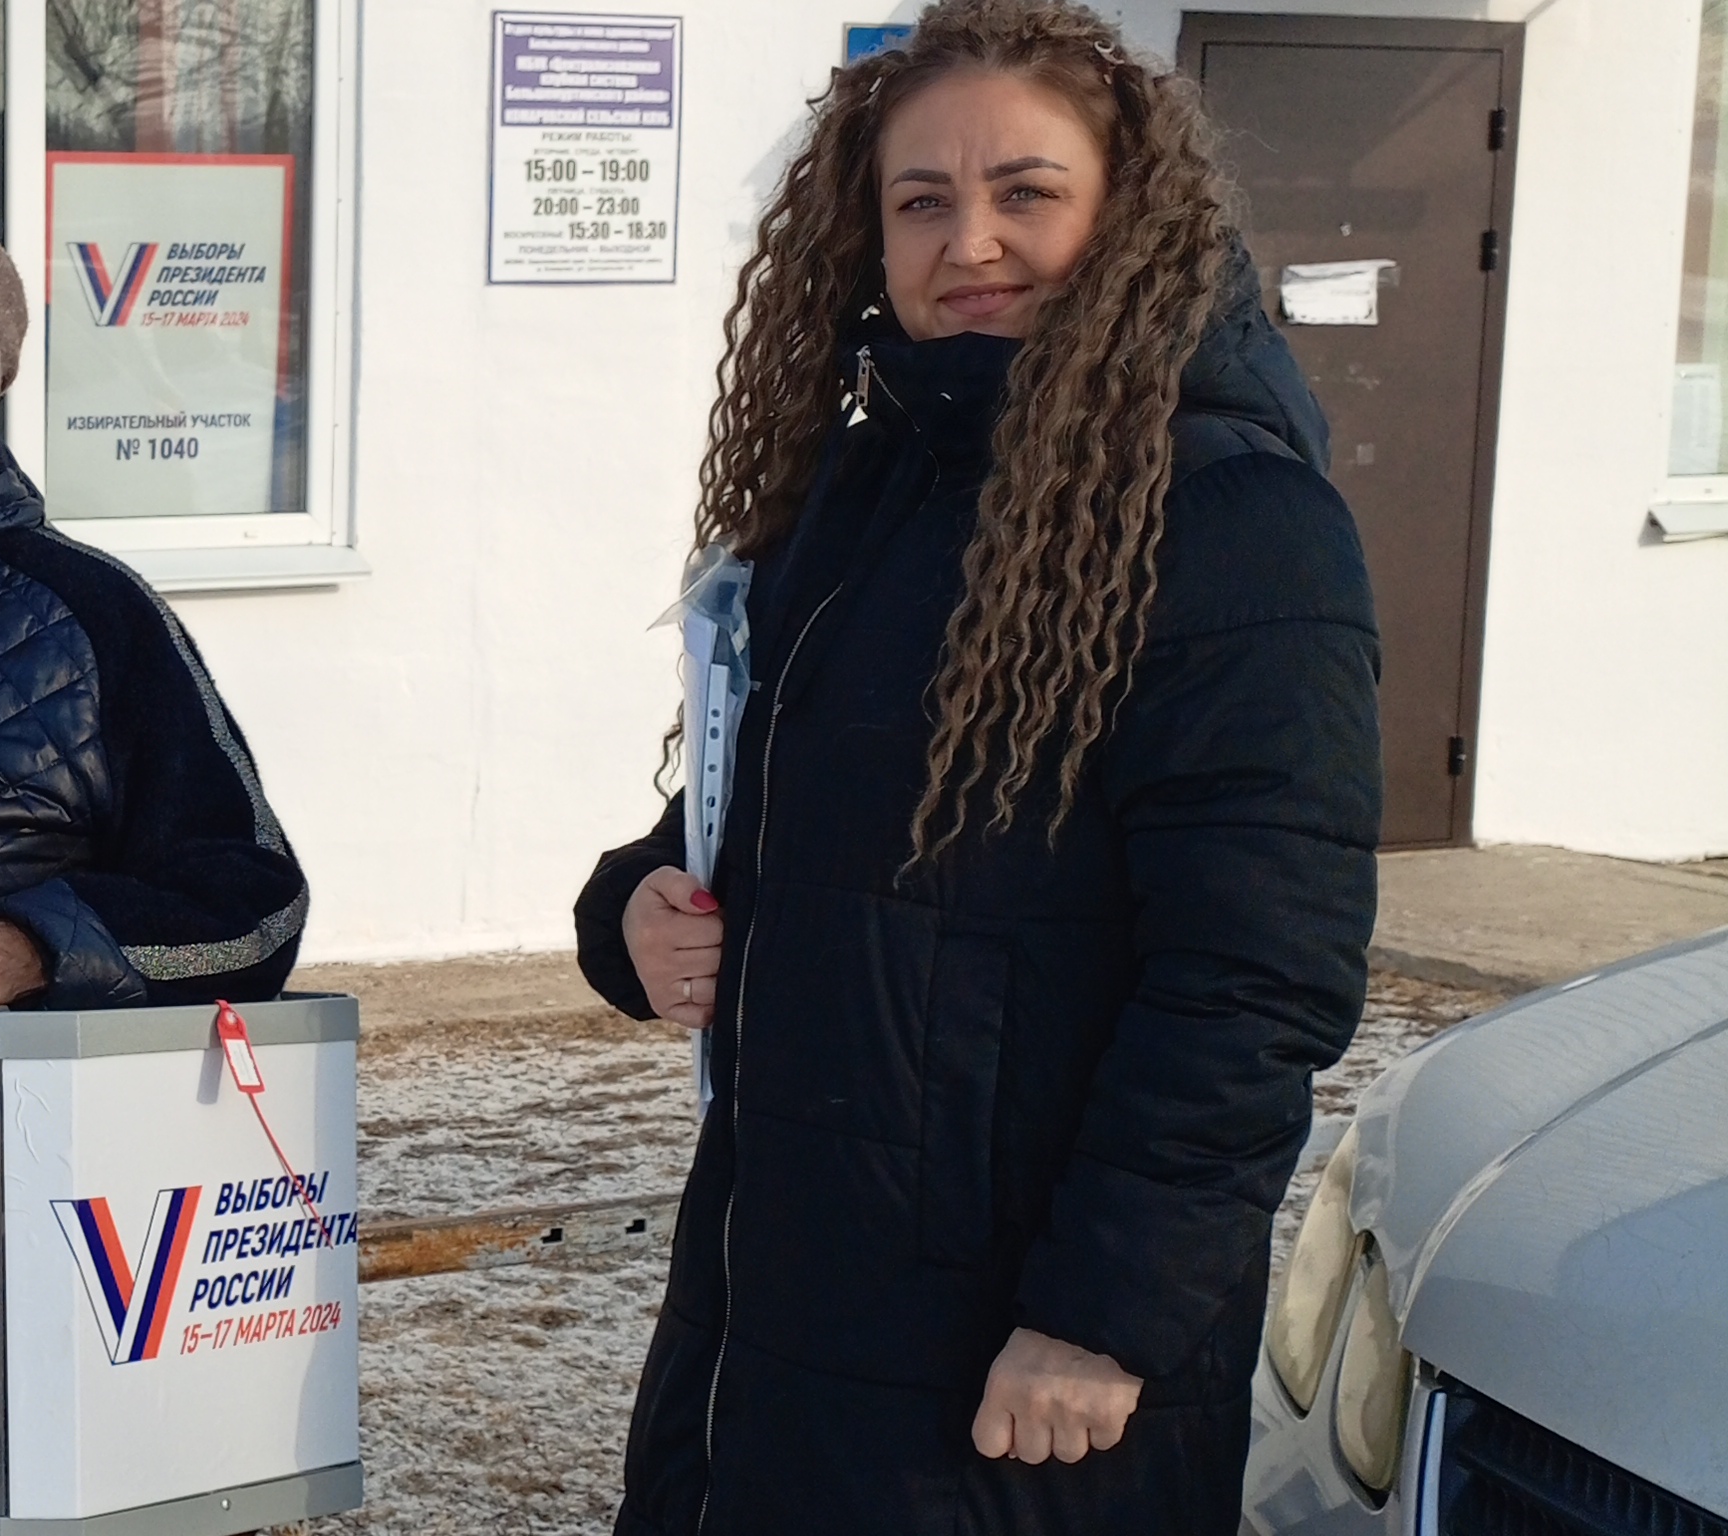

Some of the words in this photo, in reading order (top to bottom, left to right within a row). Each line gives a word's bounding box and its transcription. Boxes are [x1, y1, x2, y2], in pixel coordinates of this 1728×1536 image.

[524, 159, 578, 182] 15:00
[598, 159, 650, 182] 19:00
[533, 197, 578, 216] 20:00
[596, 197, 640, 215] 23:00
[568, 221, 610, 240] 15:30
[627, 221, 667, 240] 18:30
[166, 242, 245, 260] ВЫБОРЫ
[155, 266, 266, 285] ПРЕЗИДЕНТА
[147, 289, 219, 306] РОССИИ
[175, 311, 219, 326] МАРТА
[219, 311, 251, 326] 2024
[67, 411, 187, 430] ИЗБИРАТЕЛЬНЫЙ
[191, 413, 252, 429] УЧАСТОК
[116, 437, 140, 460] №
[148, 437, 199, 460] 1040
[214, 1171, 329, 1216] ВЫБОРЫ
[202, 1212, 358, 1264] ПРЕЗИДЕНТА
[189, 1265, 295, 1312] РОССИИ
[233, 1309, 296, 1347] МАРТА
[298, 1301, 341, 1335] 2024
